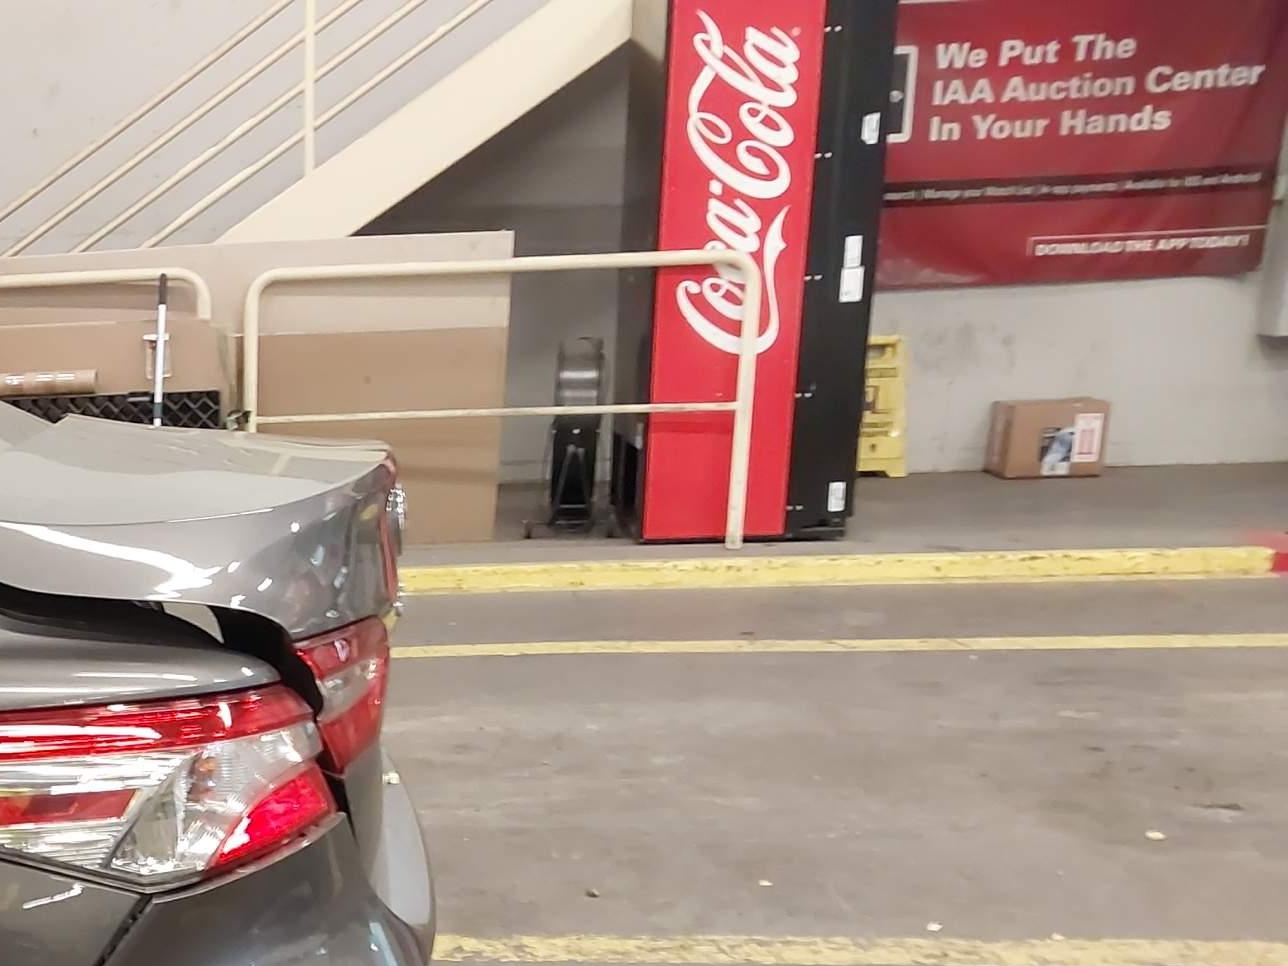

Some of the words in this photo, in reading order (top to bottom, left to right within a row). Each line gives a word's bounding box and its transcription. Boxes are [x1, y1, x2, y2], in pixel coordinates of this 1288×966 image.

[935, 42, 988, 69] We
[998, 39, 1061, 67] Put
[1072, 33, 1137, 62] The
[931, 78, 995, 105] IAA
[1000, 72, 1136, 103] Auction
[1145, 63, 1265, 93] Center
[928, 116, 961, 141] In
[971, 114, 1050, 140] Your
[1059, 104, 1172, 136] Hands
[1035, 241, 1124, 256] DOWNLOAD
[1125, 239, 1153, 252] THE
[1156, 237, 1189, 250] APP
